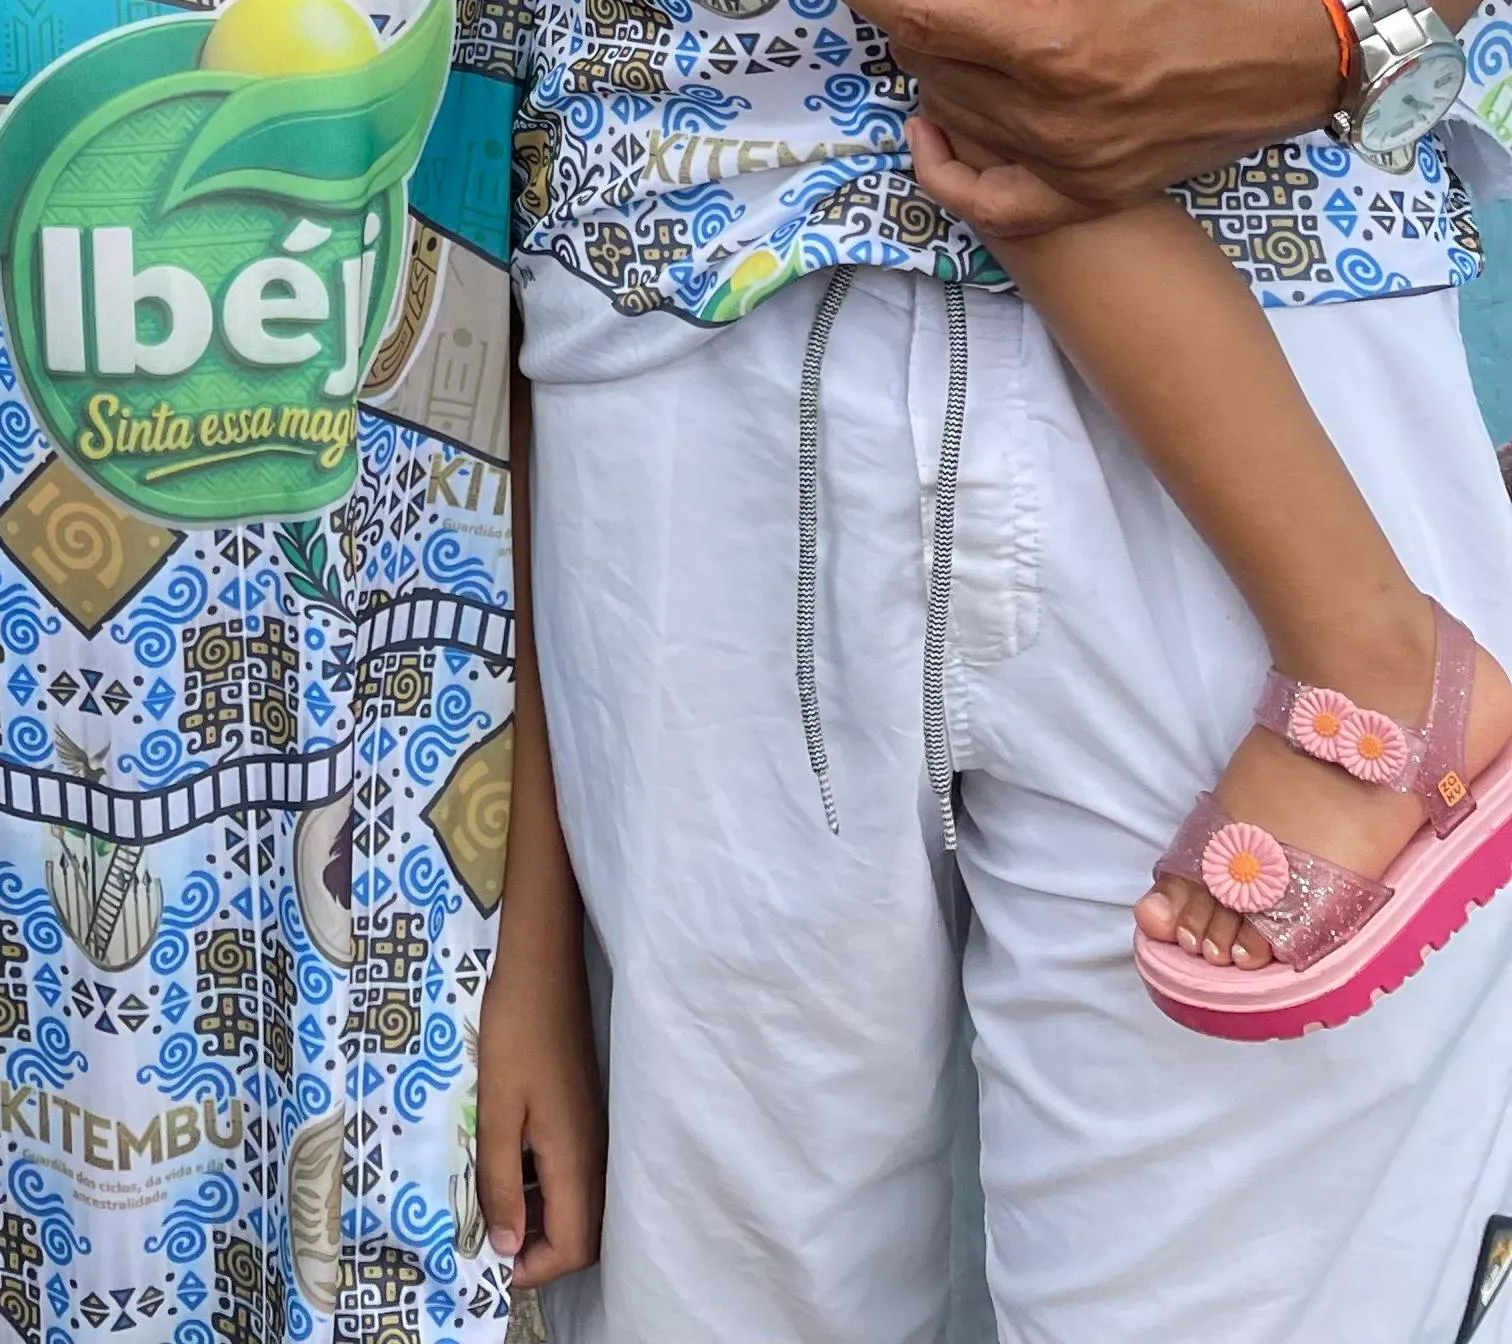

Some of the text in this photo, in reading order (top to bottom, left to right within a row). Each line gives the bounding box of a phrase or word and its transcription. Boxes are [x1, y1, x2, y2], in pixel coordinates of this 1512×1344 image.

[79, 392, 195, 460] Sinta
[200, 406, 276, 447] essa
[442, 517, 503, 539] Guardião
[145, 1175, 162, 1188] da
[164, 1163, 192, 1182] vida
[207, 1158, 224, 1173] da
[72, 1188, 168, 1211] ancestralidade
